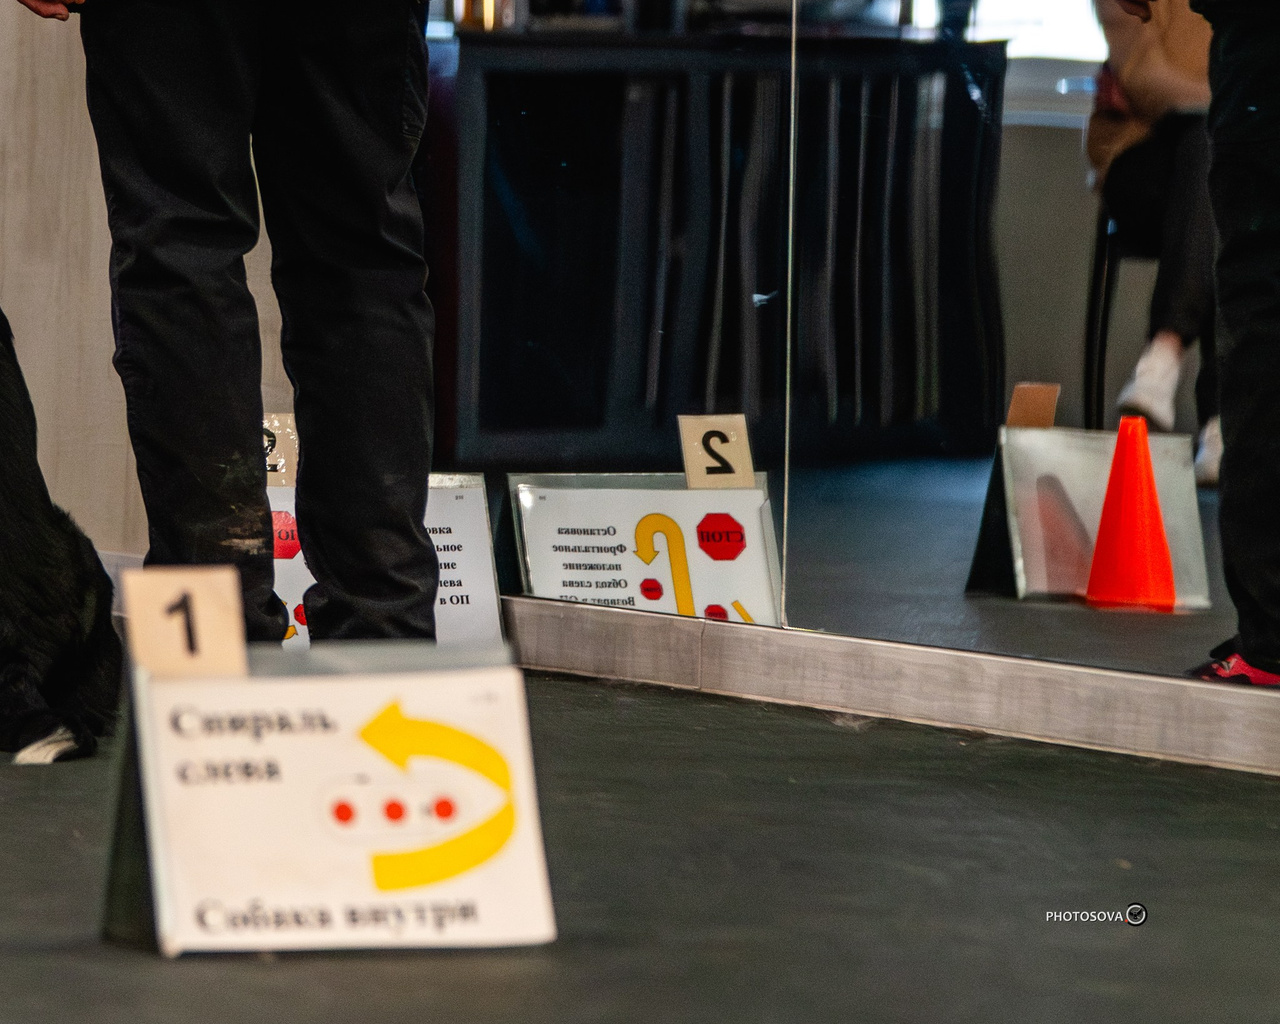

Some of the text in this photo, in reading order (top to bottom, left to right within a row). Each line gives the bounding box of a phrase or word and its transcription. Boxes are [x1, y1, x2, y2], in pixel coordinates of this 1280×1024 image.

[449, 594, 471, 605] ОП
[164, 588, 199, 656] 1
[170, 704, 337, 742] Спираль
[176, 758, 283, 786] слева
[196, 898, 480, 937] Собака внутри
